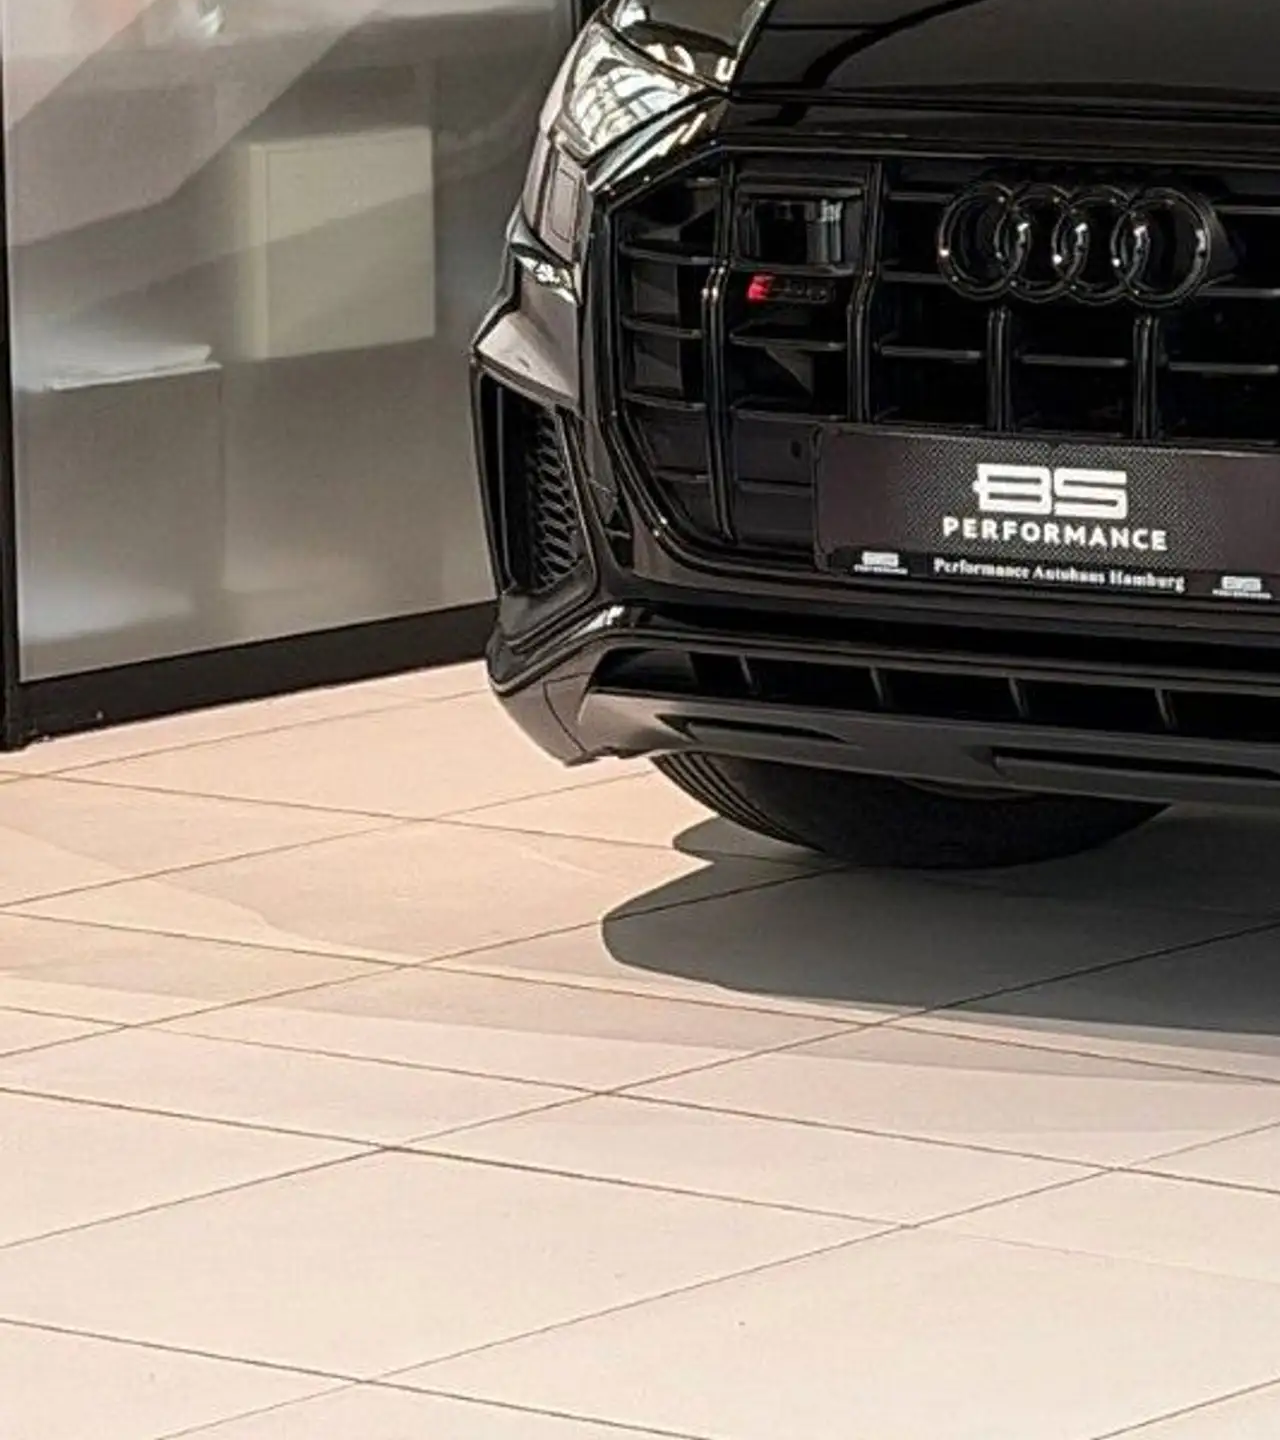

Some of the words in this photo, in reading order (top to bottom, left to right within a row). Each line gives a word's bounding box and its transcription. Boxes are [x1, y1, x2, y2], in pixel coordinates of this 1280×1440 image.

[972, 462, 1127, 520] BS
[943, 515, 1168, 552] PERFORMANCE
[933, 557, 1029, 579] Performance
[1031, 564, 1106, 585] Autohaus
[1109, 569, 1186, 594] Hamburg
